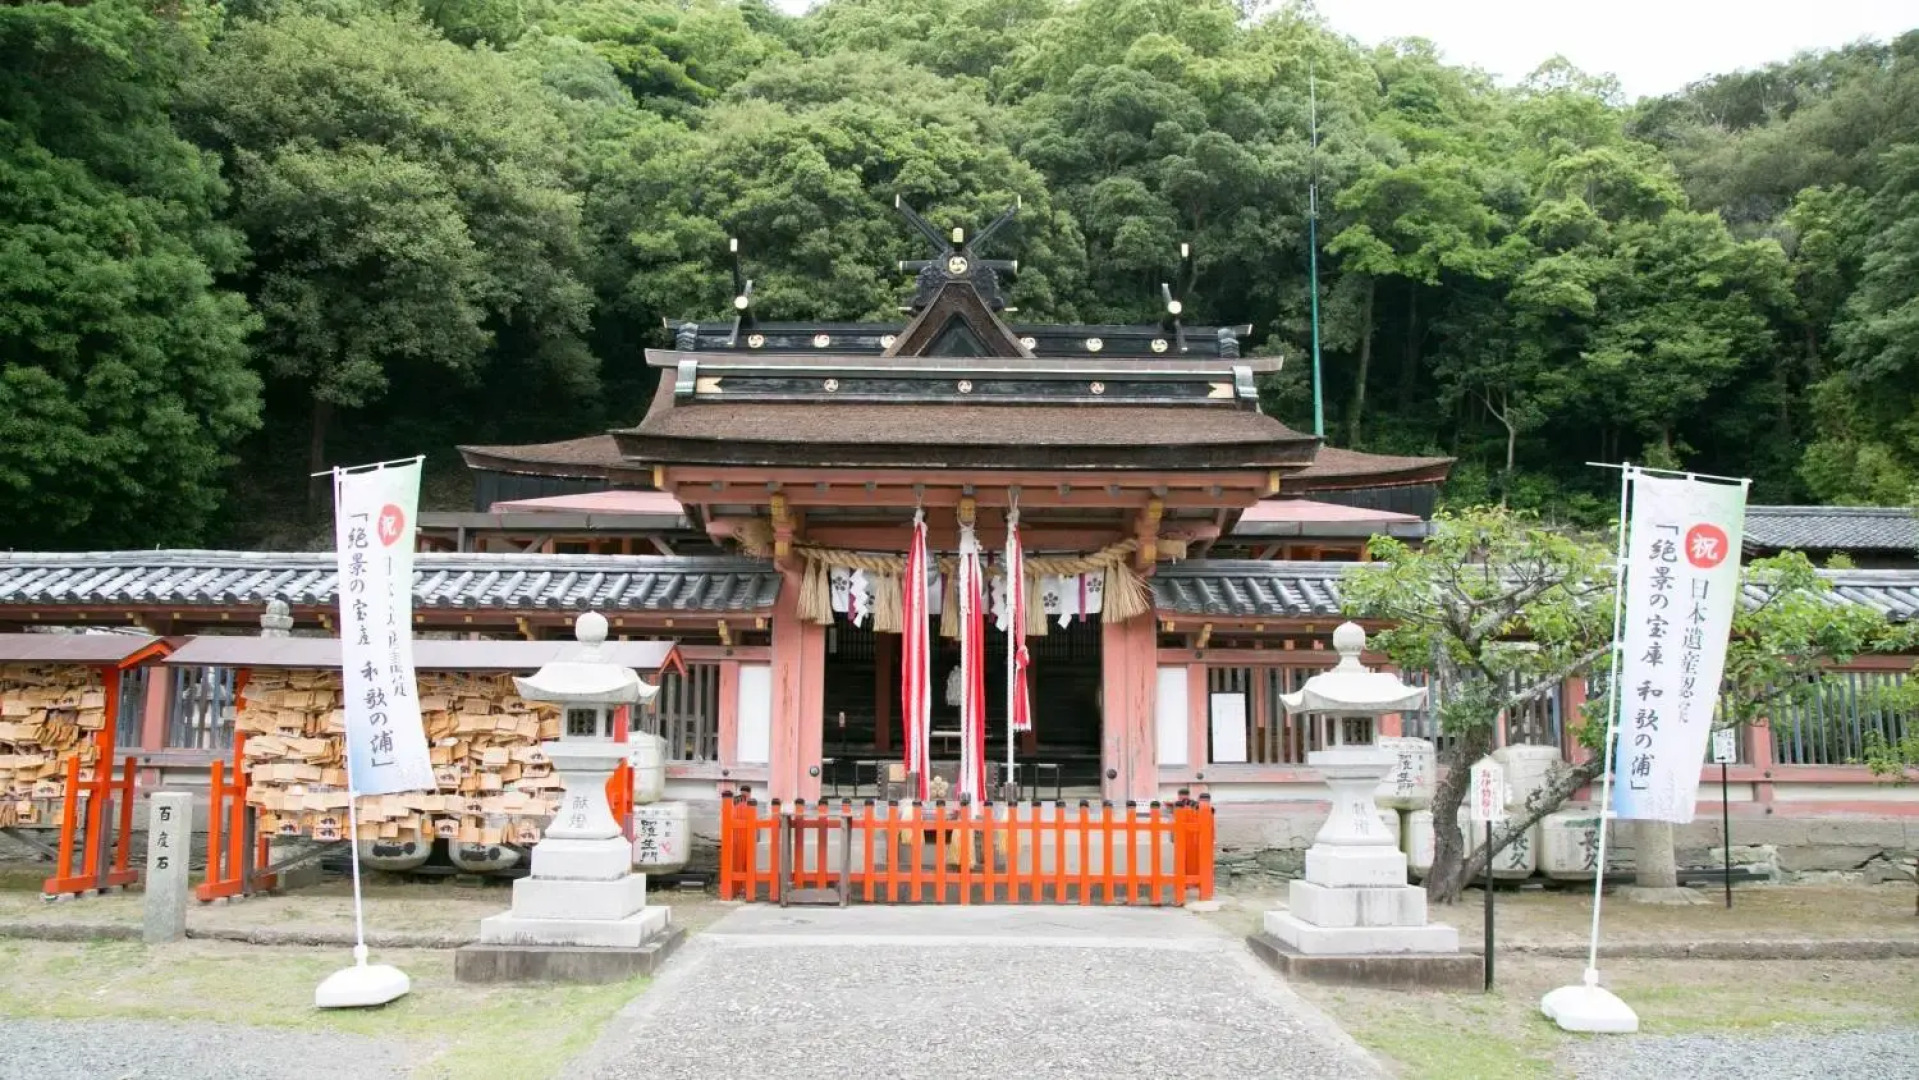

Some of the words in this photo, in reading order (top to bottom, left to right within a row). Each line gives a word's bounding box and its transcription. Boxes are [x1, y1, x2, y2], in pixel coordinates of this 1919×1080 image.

[1691, 533, 1718, 560] 祝
[1640, 523, 1680, 667] 「絶景の宝庫
[1630, 680, 1664, 791] 和歌の浦」
[156, 805, 172, 870] 百度石
